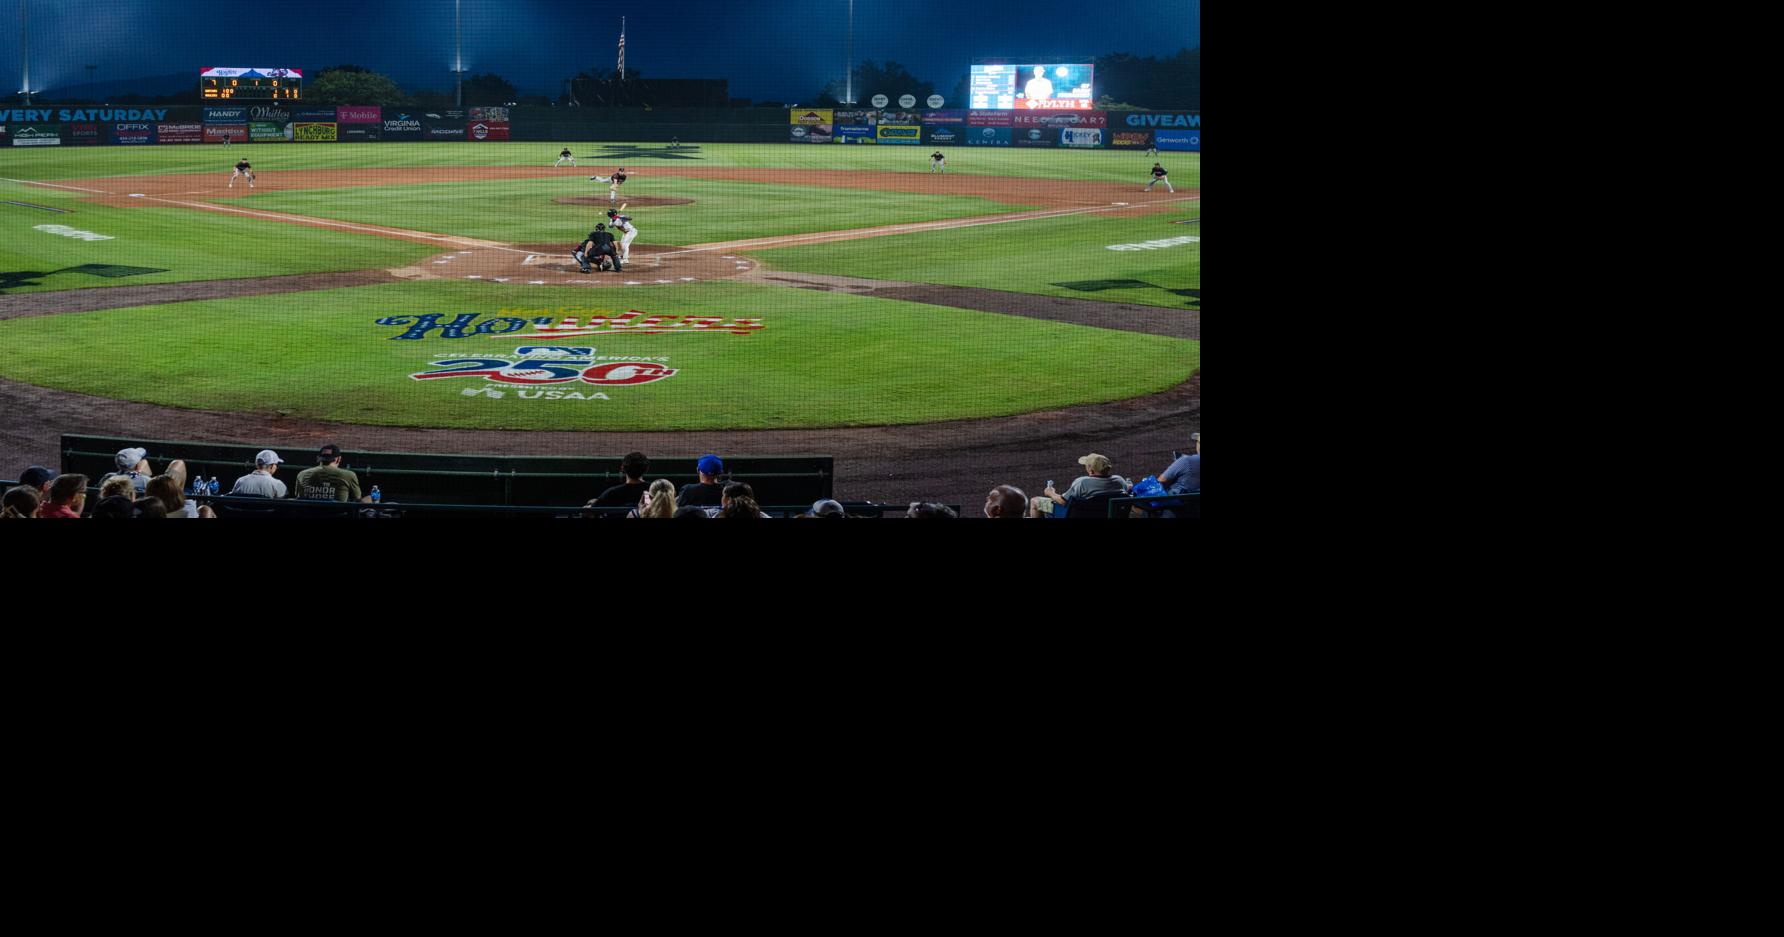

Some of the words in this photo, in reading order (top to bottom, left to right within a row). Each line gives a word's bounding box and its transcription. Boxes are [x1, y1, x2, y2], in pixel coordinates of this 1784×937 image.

[59, 109, 168, 121] SATURDAY
[350, 111, 377, 119] Mobile
[207, 127, 244, 135] Maddox
[295, 125, 336, 135] LYNCHBURG
[375, 309, 768, 340] Howlers
[517, 390, 609, 400] USAA
